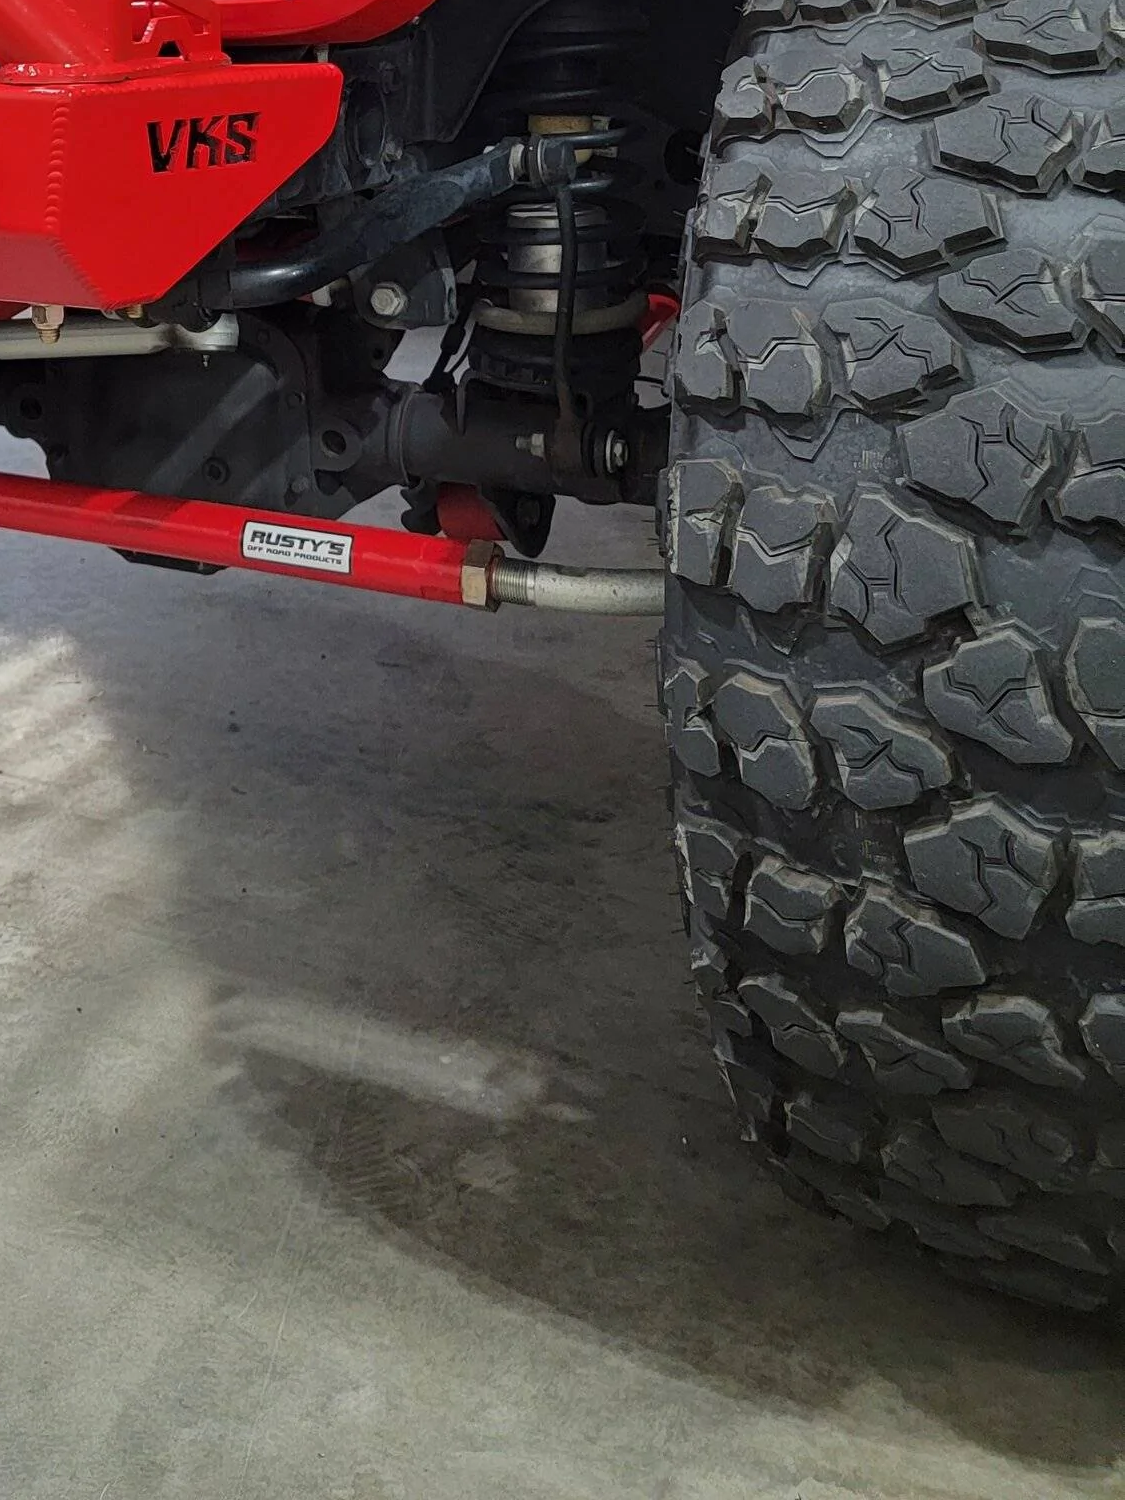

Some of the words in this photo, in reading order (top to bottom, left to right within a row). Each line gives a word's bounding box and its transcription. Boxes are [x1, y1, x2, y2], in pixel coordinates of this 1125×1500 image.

[147, 112, 262, 173] VKS
[247, 545, 263, 553] OFF
[266, 548, 291, 557] ROAD
[294, 551, 342, 565] PRODUCTS
[250, 529, 345, 556] RUSTY'S
